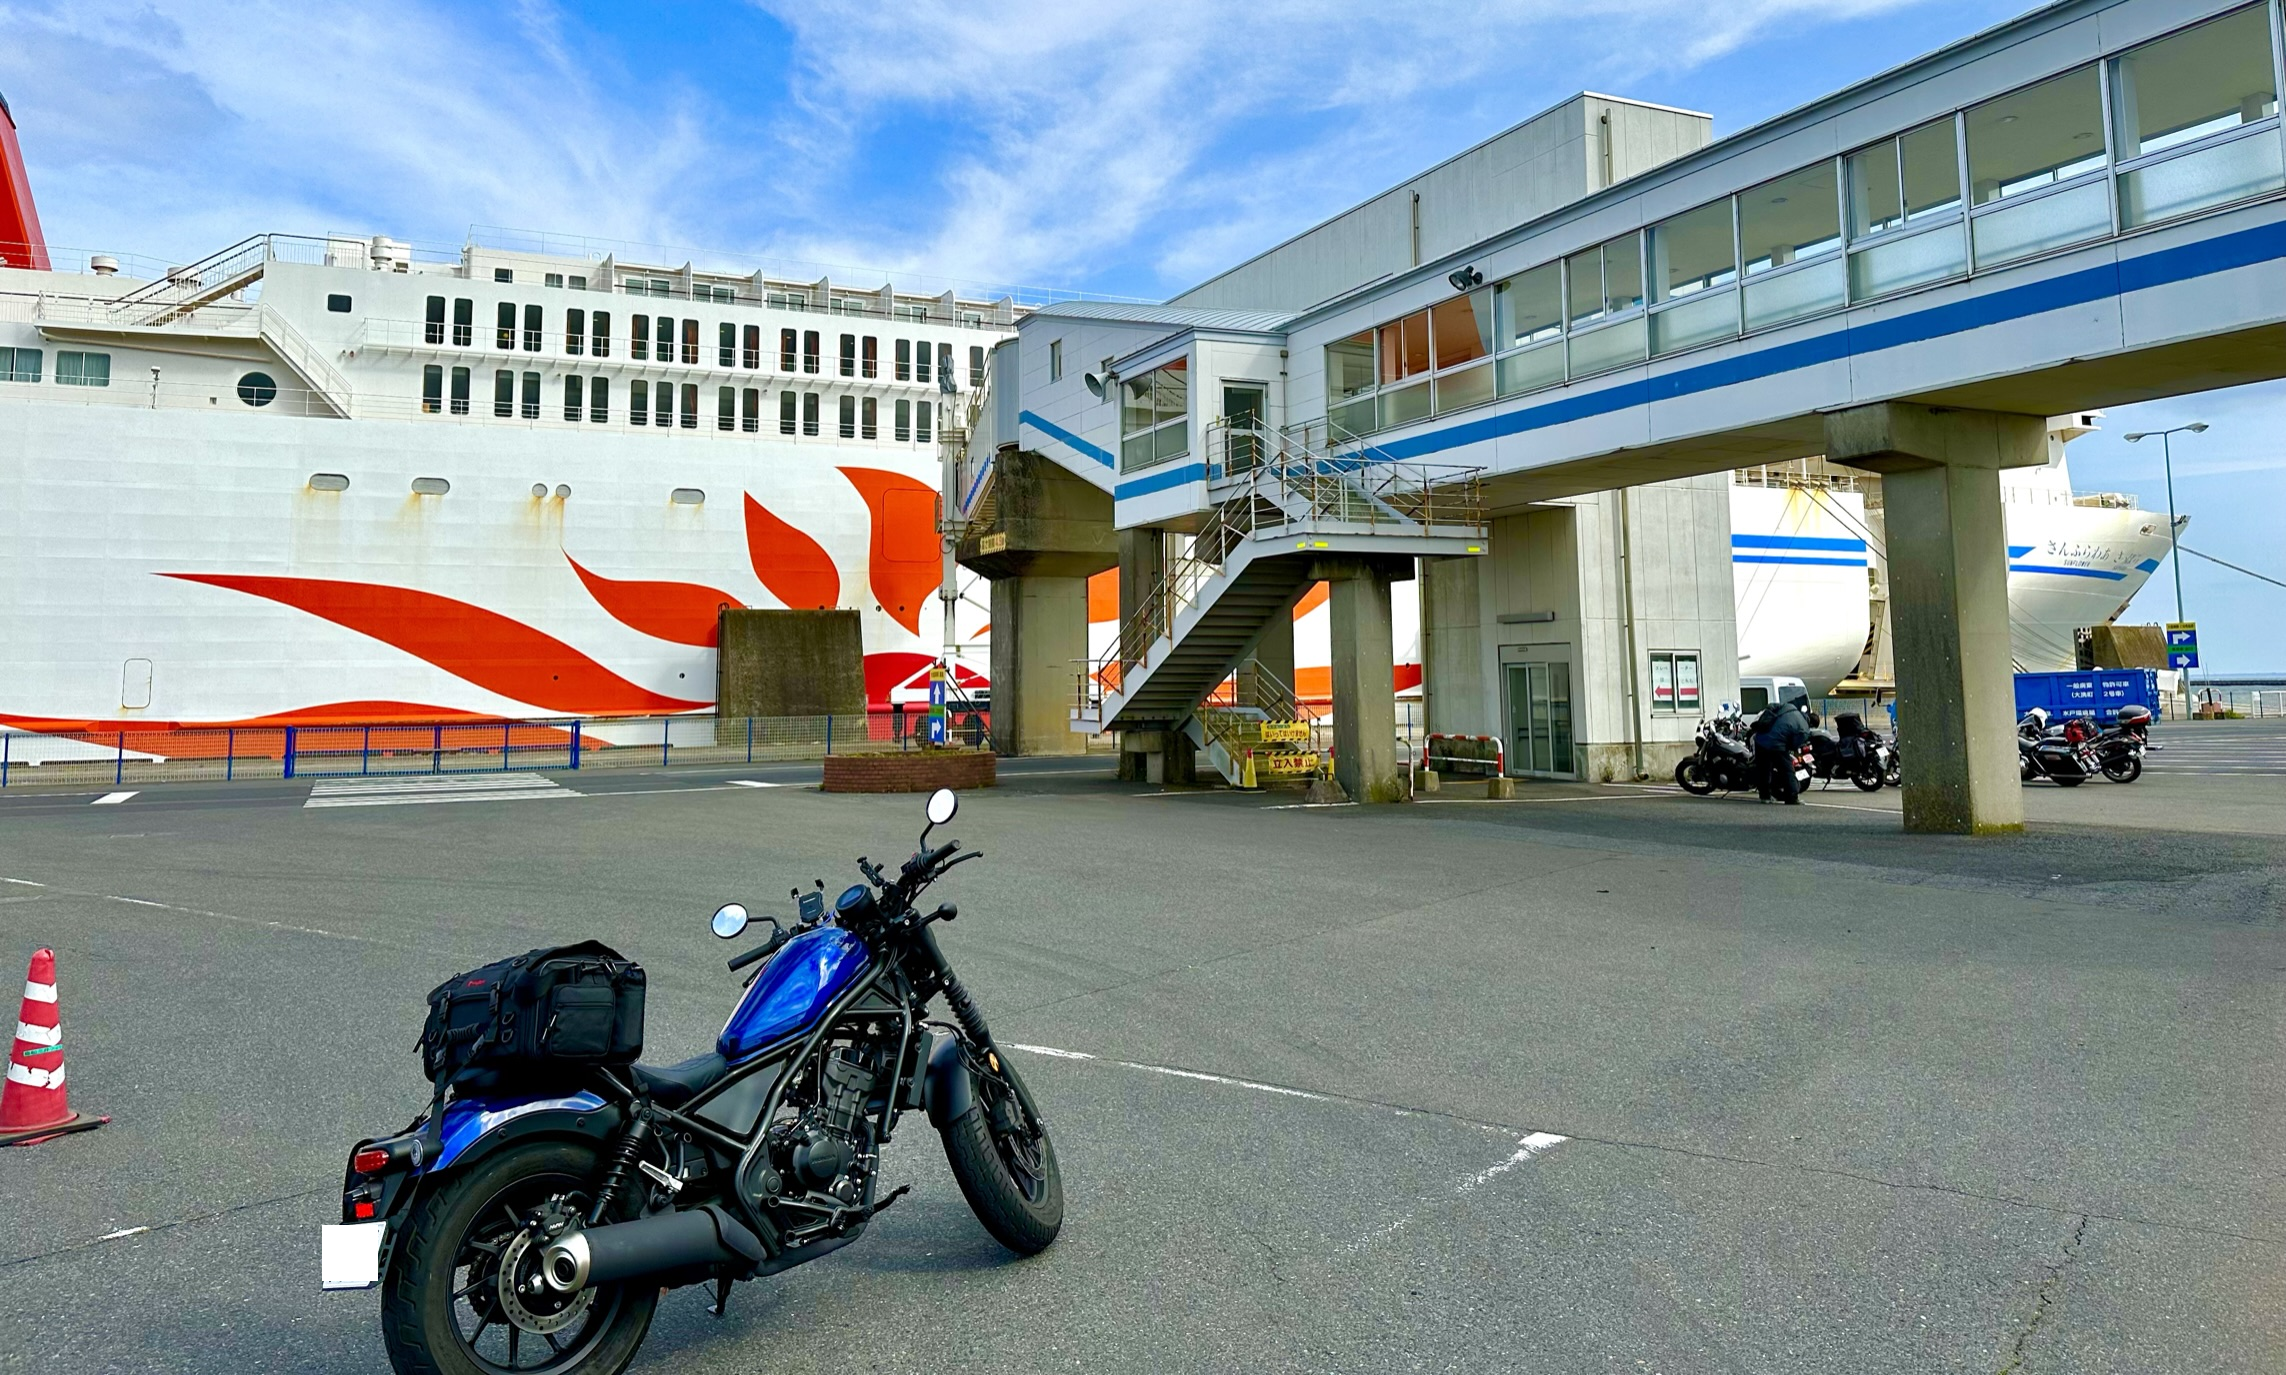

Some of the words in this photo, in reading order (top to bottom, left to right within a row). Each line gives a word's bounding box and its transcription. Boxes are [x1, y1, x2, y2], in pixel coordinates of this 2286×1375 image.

[2047, 540, 2111, 561] さんふらわあ
[1273, 757, 1315, 769] 立入禁止
